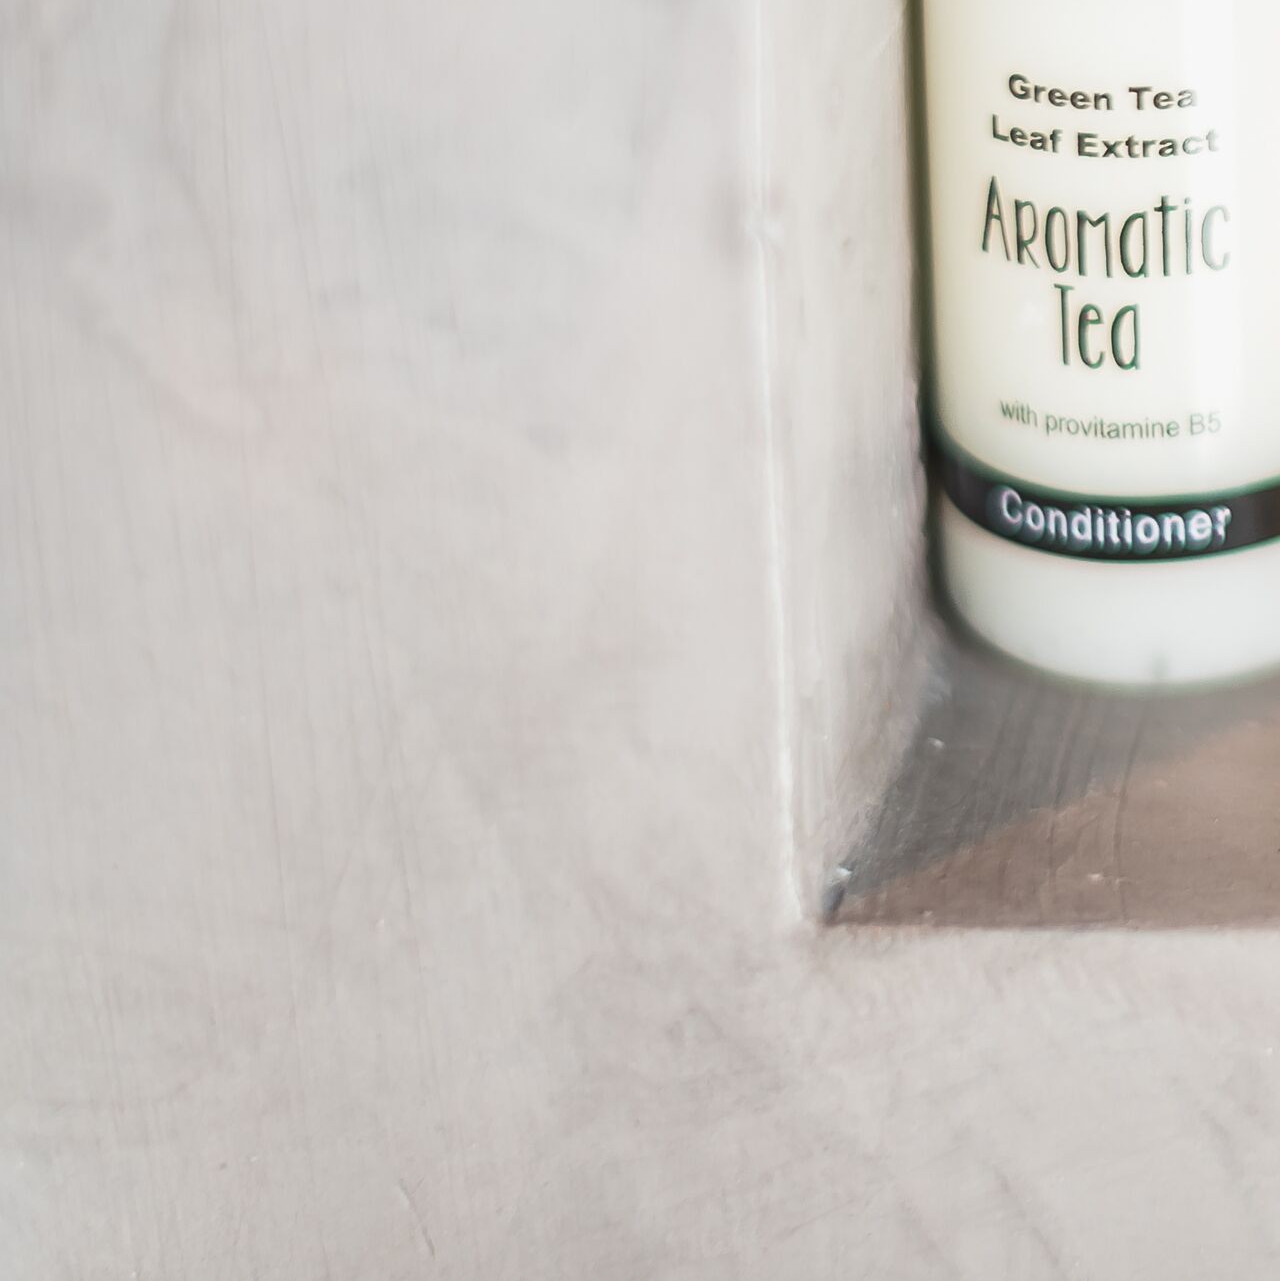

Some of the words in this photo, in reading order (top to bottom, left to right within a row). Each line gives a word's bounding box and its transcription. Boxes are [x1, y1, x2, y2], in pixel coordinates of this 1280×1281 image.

[1008, 74, 1113, 110] Green
[1129, 86, 1198, 110] Tea
[992, 114, 1062, 153] Leaf
[1077, 128, 1220, 159] Extract
[981, 175, 1231, 278] Aromatic
[1054, 283, 1141, 371] Tea
[1000, 399, 1038, 429] with
[1044, 408, 1180, 439] provitamine
[1189, 412, 1222, 435] B5
[999, 487, 1232, 545] Conditioner
